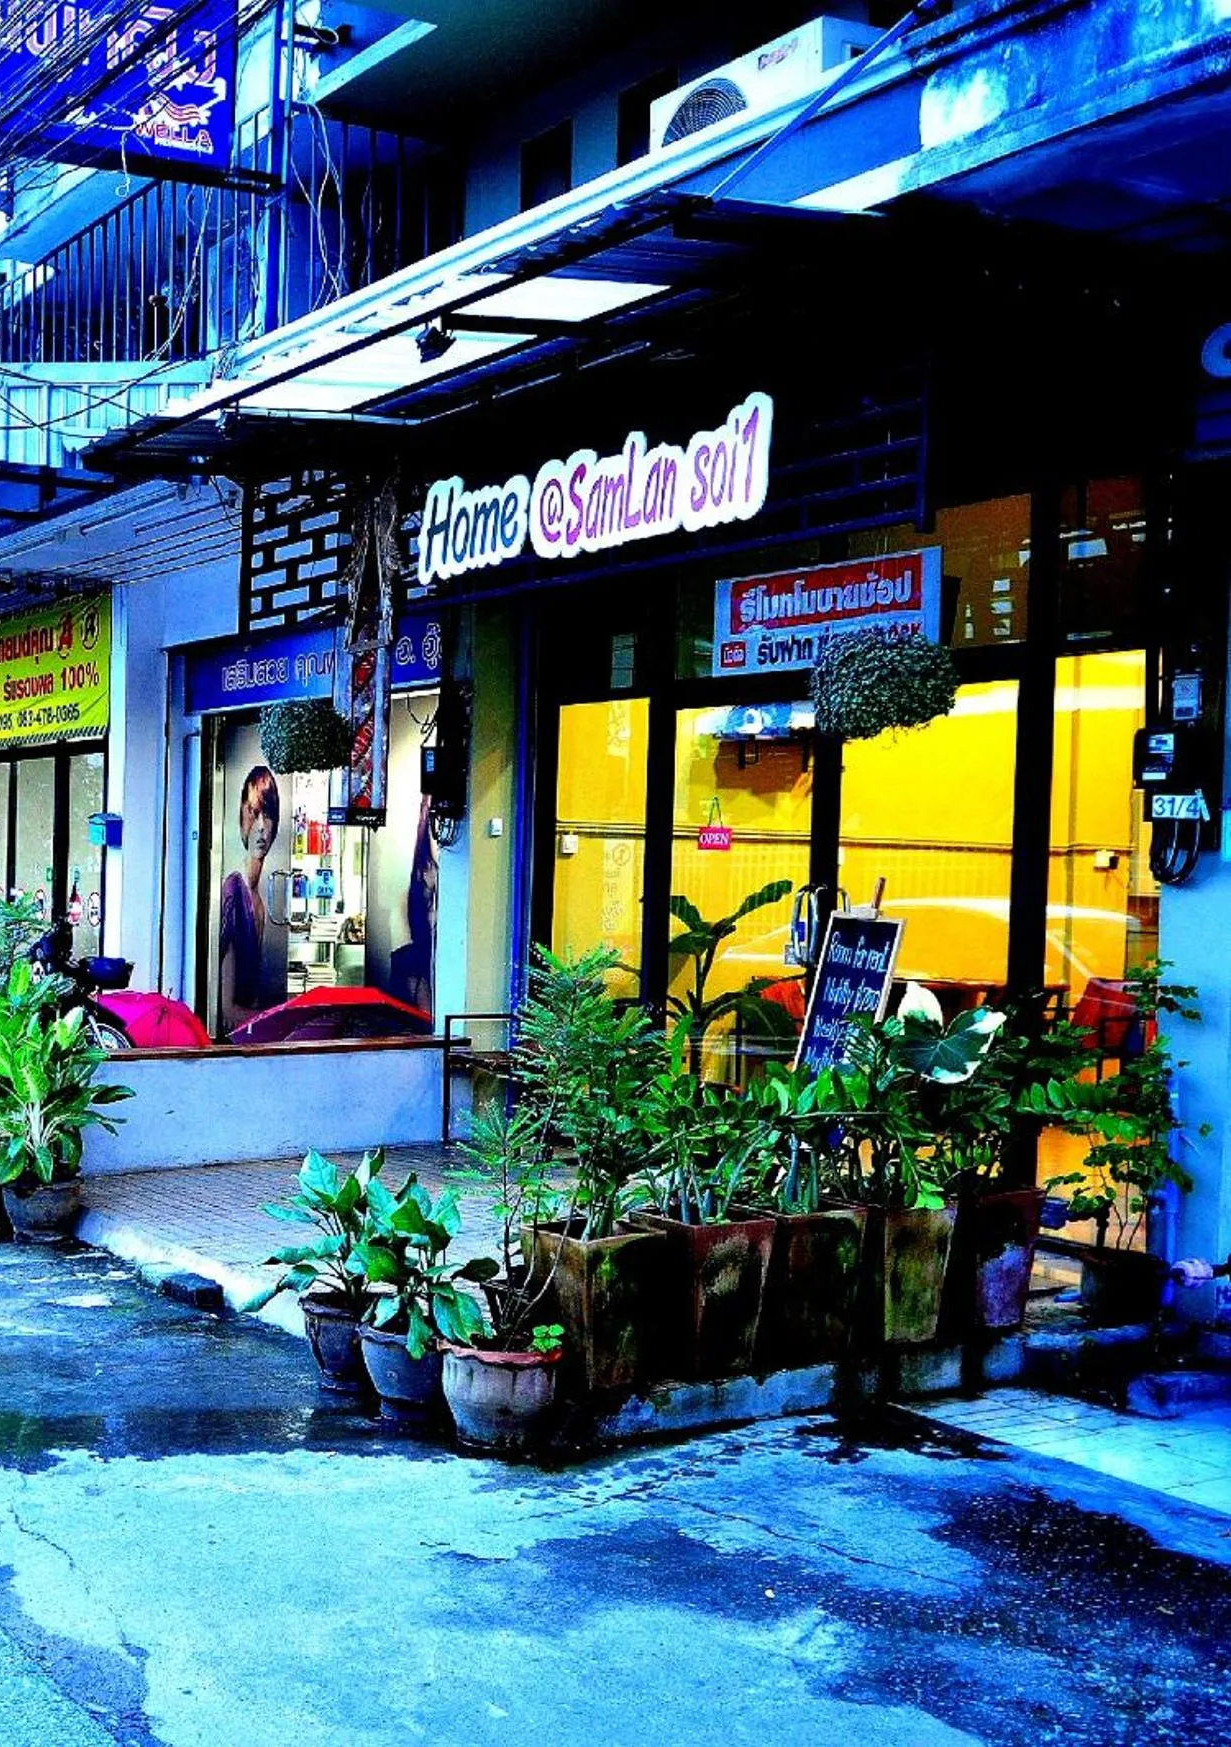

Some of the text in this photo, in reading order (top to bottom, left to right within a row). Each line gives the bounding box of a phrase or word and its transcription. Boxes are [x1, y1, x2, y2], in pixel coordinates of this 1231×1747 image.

[136, 121, 213, 149] WELLA
[422, 482, 520, 574] Home
[538, 439, 679, 547] @SamLan
[60, 662, 100, 692] 100%
[1154, 796, 1200, 817] 31/4
[699, 832, 729, 845] OPEN
[827, 931, 890, 973] Room for rent
